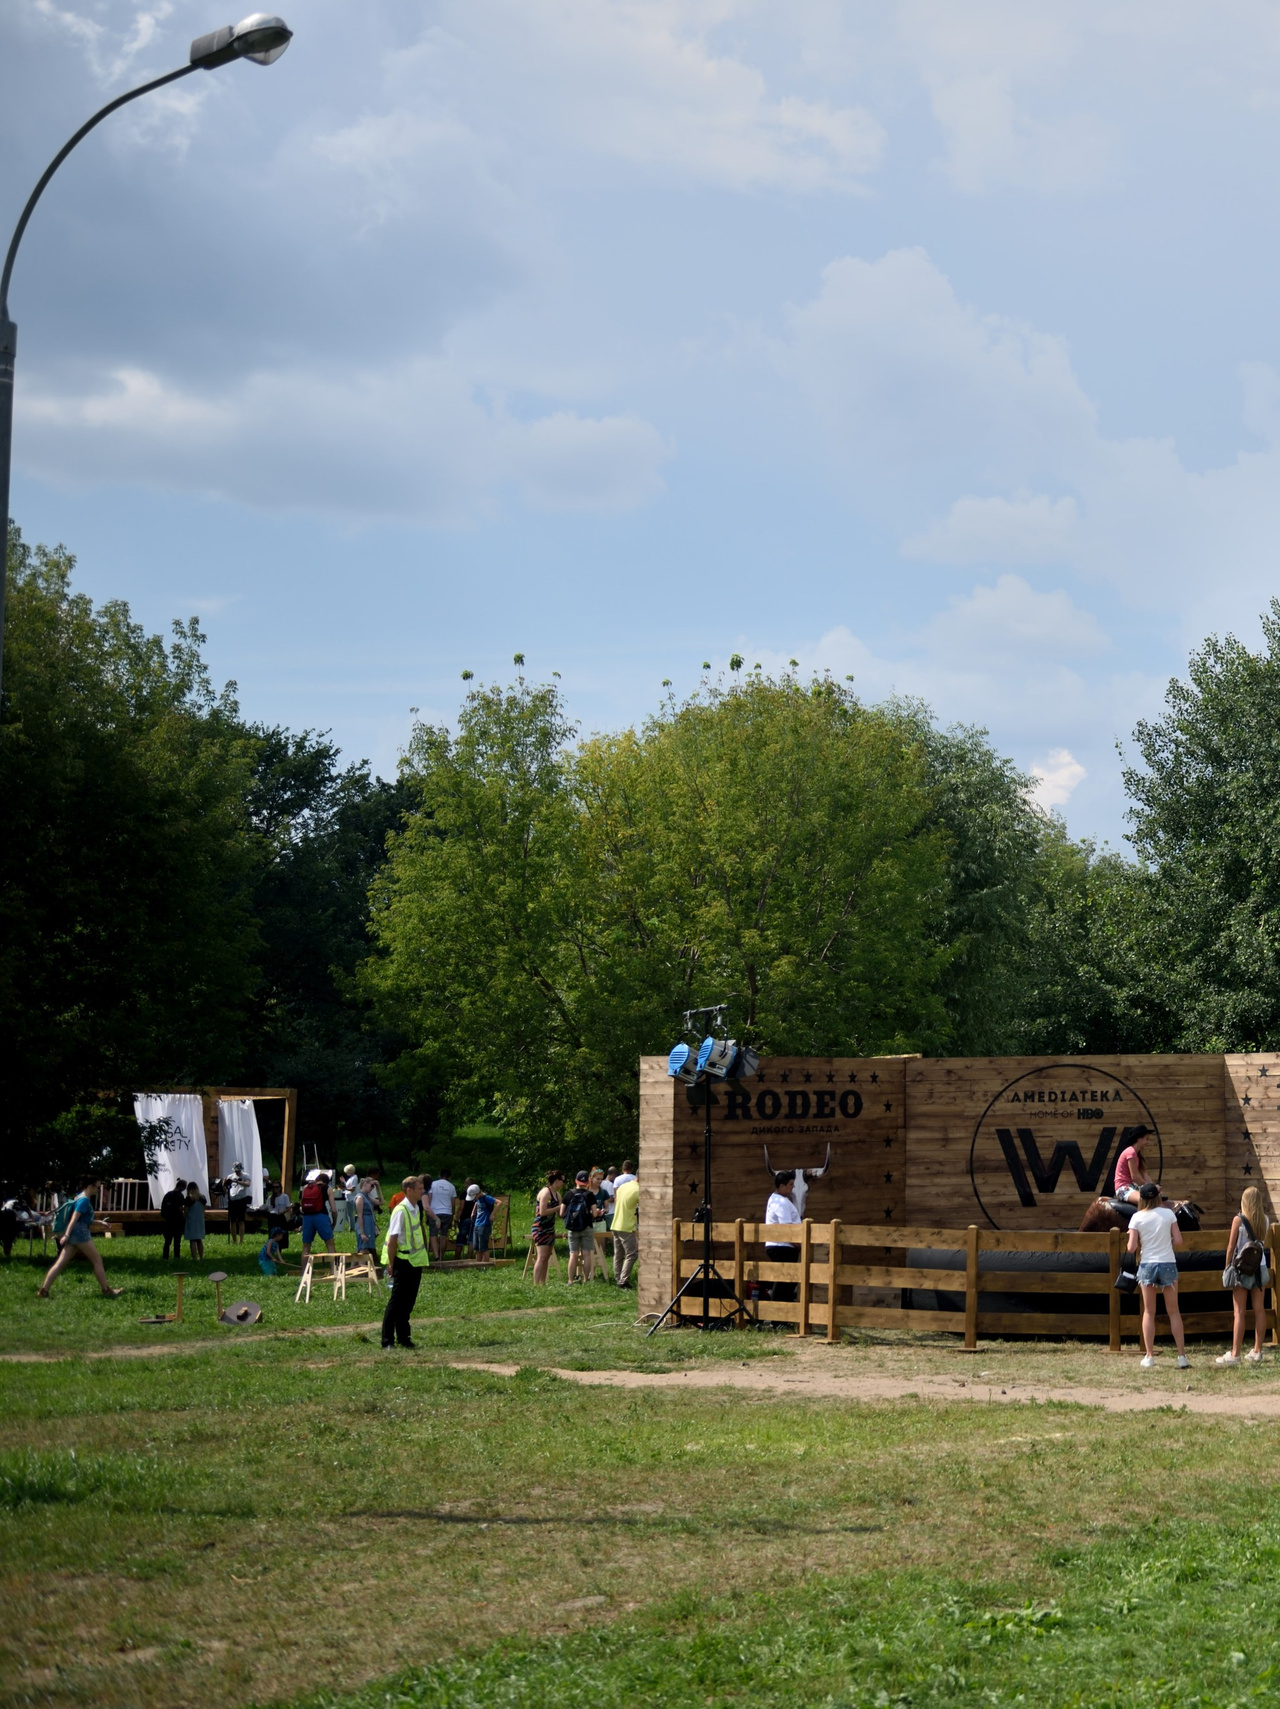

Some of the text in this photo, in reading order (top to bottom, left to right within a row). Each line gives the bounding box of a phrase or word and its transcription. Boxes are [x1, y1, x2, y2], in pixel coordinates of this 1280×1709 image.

[1012, 1091, 1123, 1103] AMEDIATEKA
[723, 1089, 864, 1120] RODEO
[1029, 1108, 1104, 1120] HOME OF HBO
[751, 1125, 840, 1135] ДИКОГО ЗАПАДА
